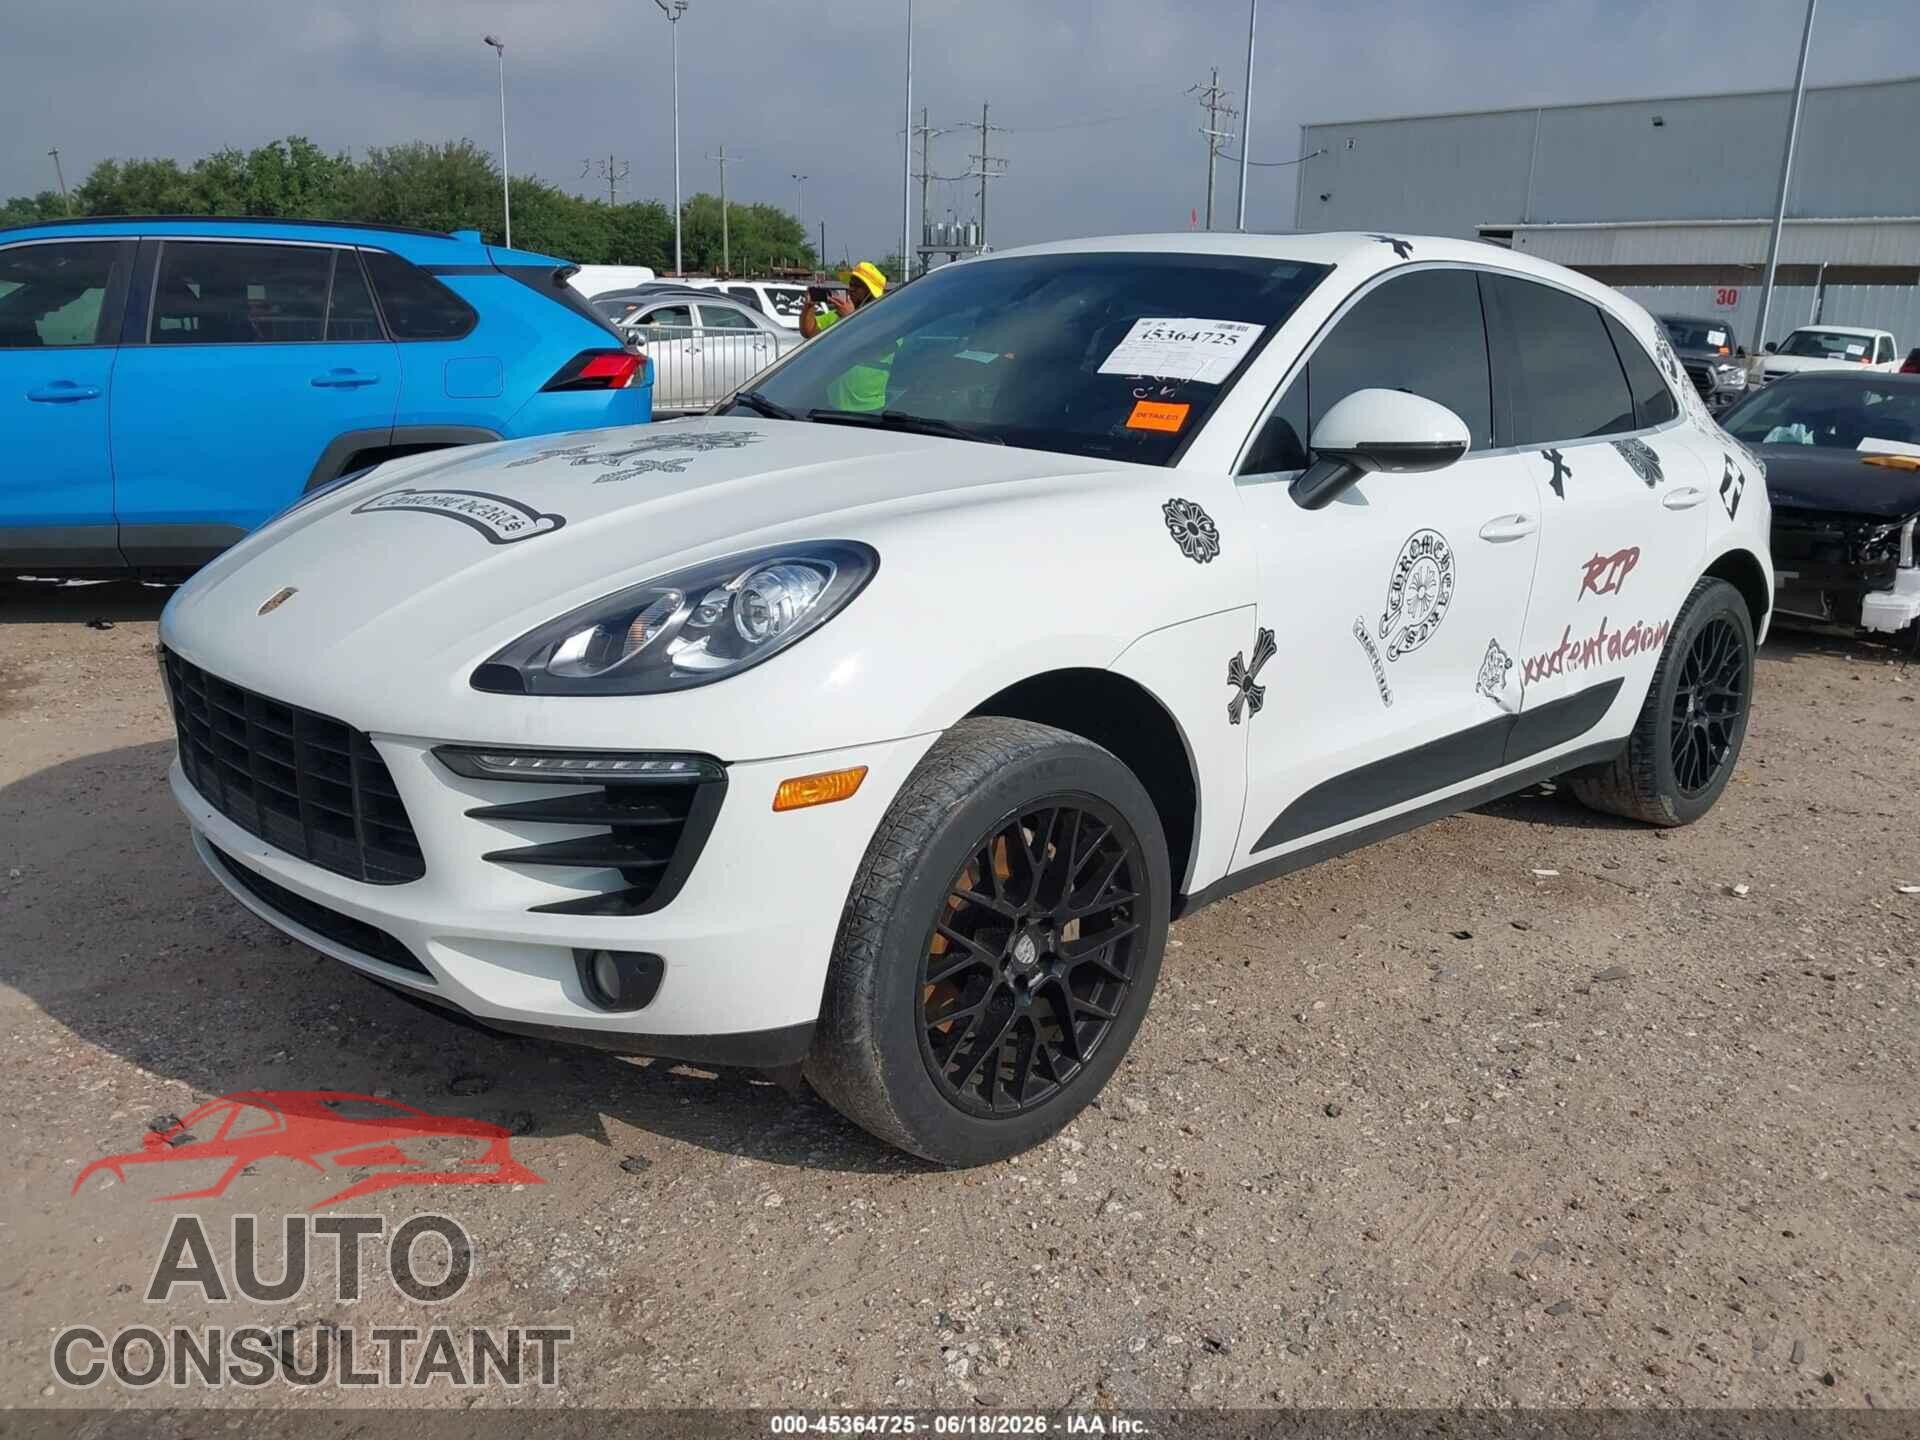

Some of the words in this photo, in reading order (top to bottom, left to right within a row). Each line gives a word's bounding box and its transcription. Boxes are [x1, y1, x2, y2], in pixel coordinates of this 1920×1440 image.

[1716, 288, 1737, 305] 30
[1138, 328, 1240, 347] 45364725
[1577, 546, 1641, 602] RIP
